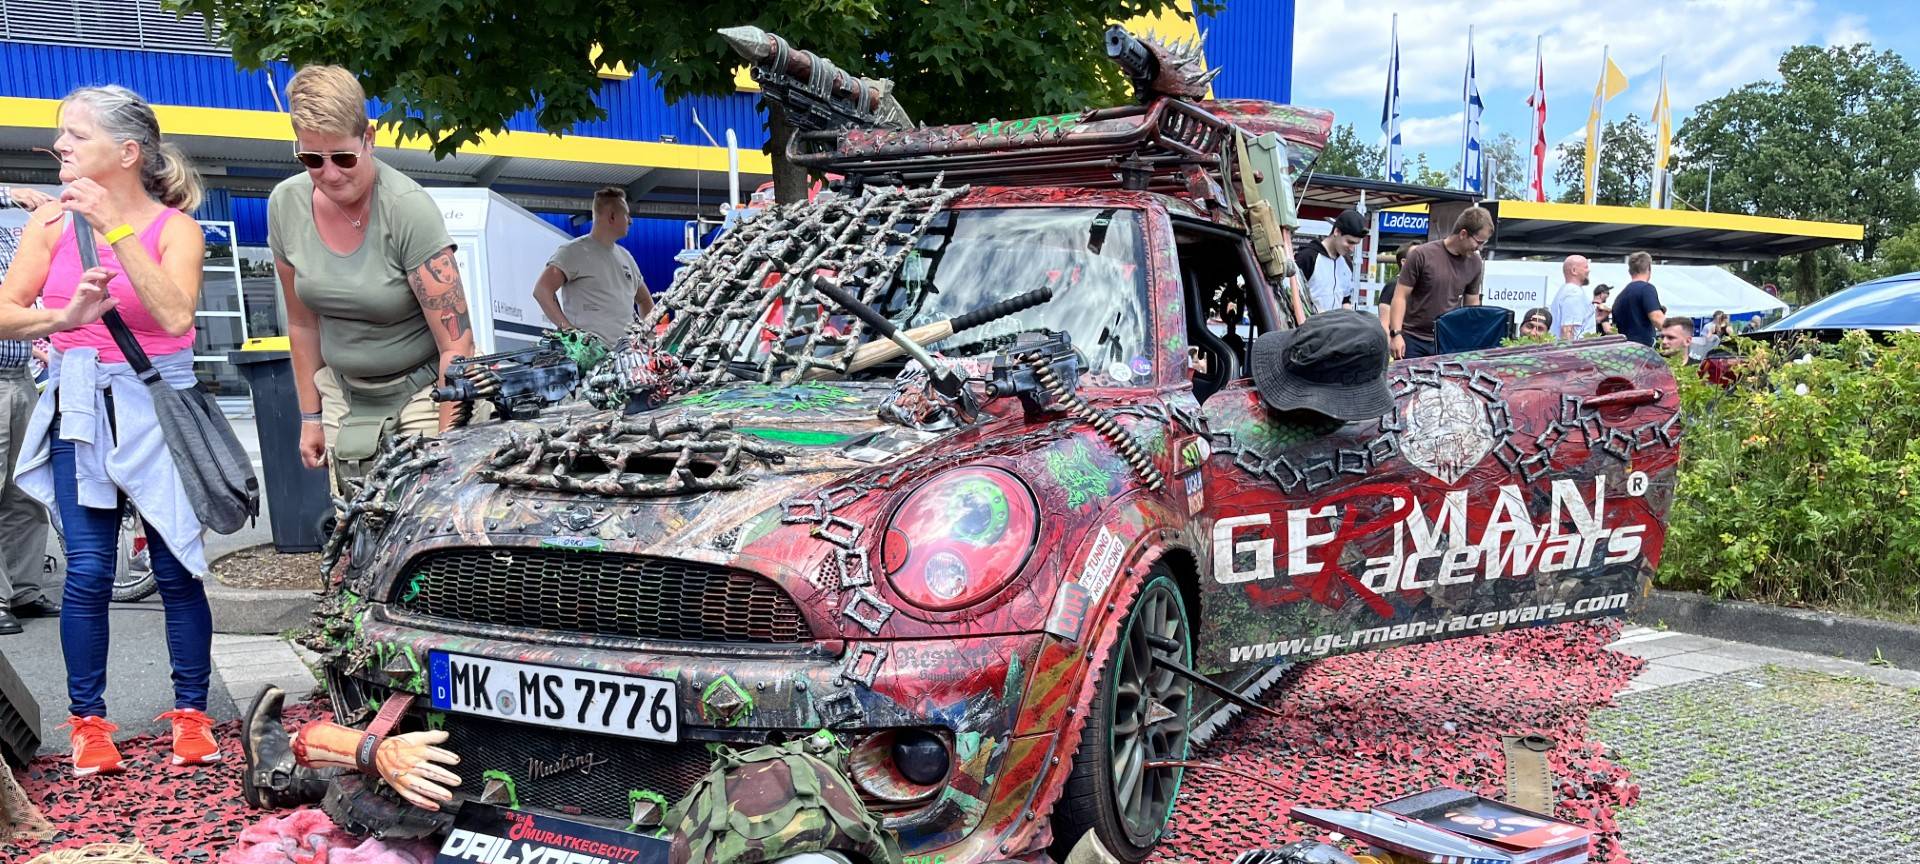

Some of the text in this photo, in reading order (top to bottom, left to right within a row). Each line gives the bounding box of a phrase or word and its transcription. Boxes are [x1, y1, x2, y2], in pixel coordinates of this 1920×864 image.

[1488, 288, 1537, 302] Ladezone
[1087, 533, 1110, 572] TUNING
[1213, 474, 1605, 600] GERMAN
[1094, 541, 1123, 597] NOT RACING
[437, 686, 446, 700] D
[450, 661, 673, 733] MK MS 7776
[526, 753, 609, 782] Mustang
